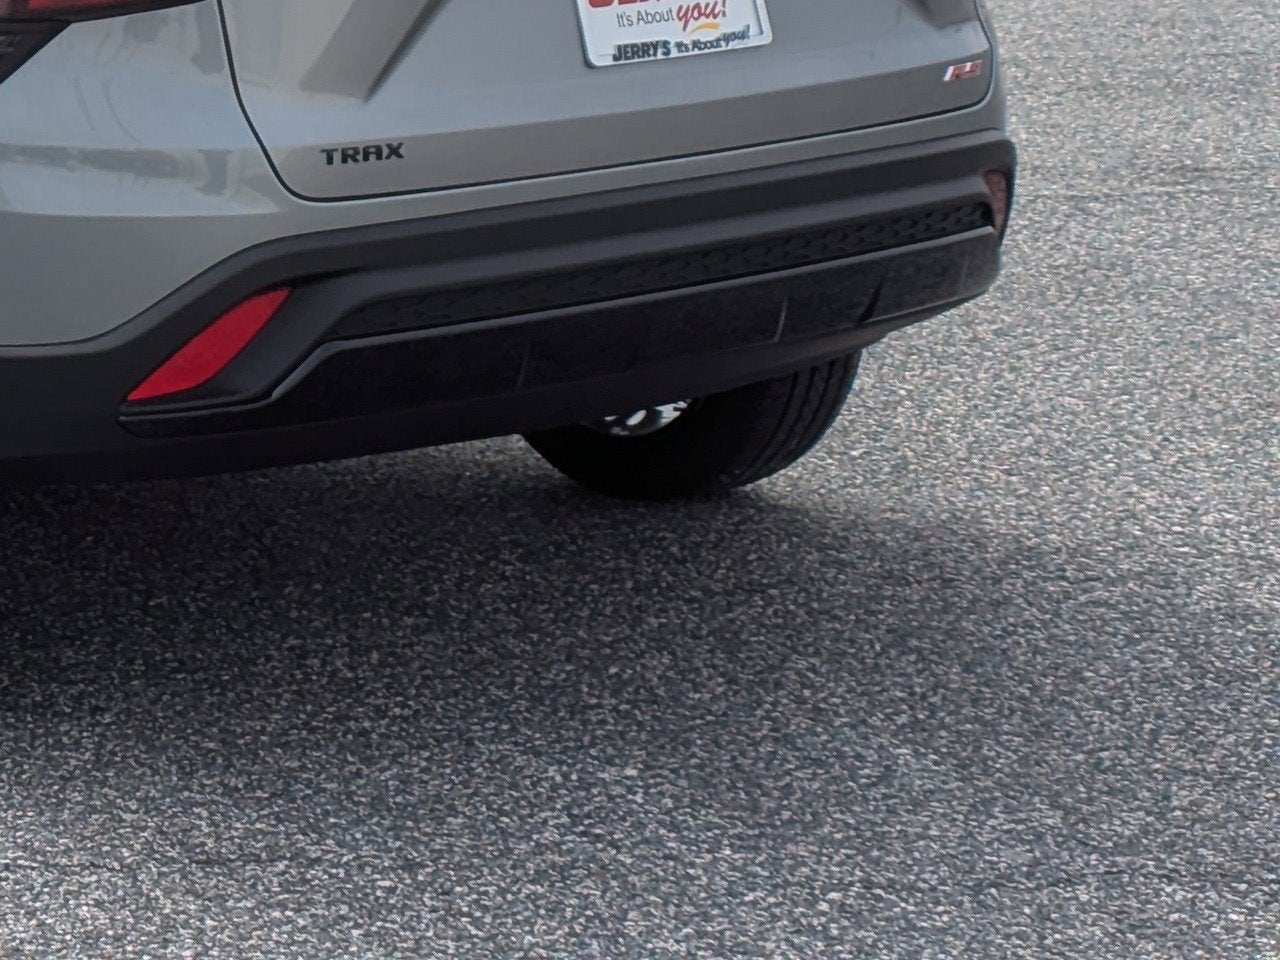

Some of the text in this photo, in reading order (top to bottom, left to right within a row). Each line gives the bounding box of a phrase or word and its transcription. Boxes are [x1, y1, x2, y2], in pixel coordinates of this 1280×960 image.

[616, 10, 634, 28] It's
[636, 7, 675, 26] About
[612, 40, 672, 63] JERRY'S
[690, 37, 722, 52] About
[320, 142, 405, 167] TRAX
